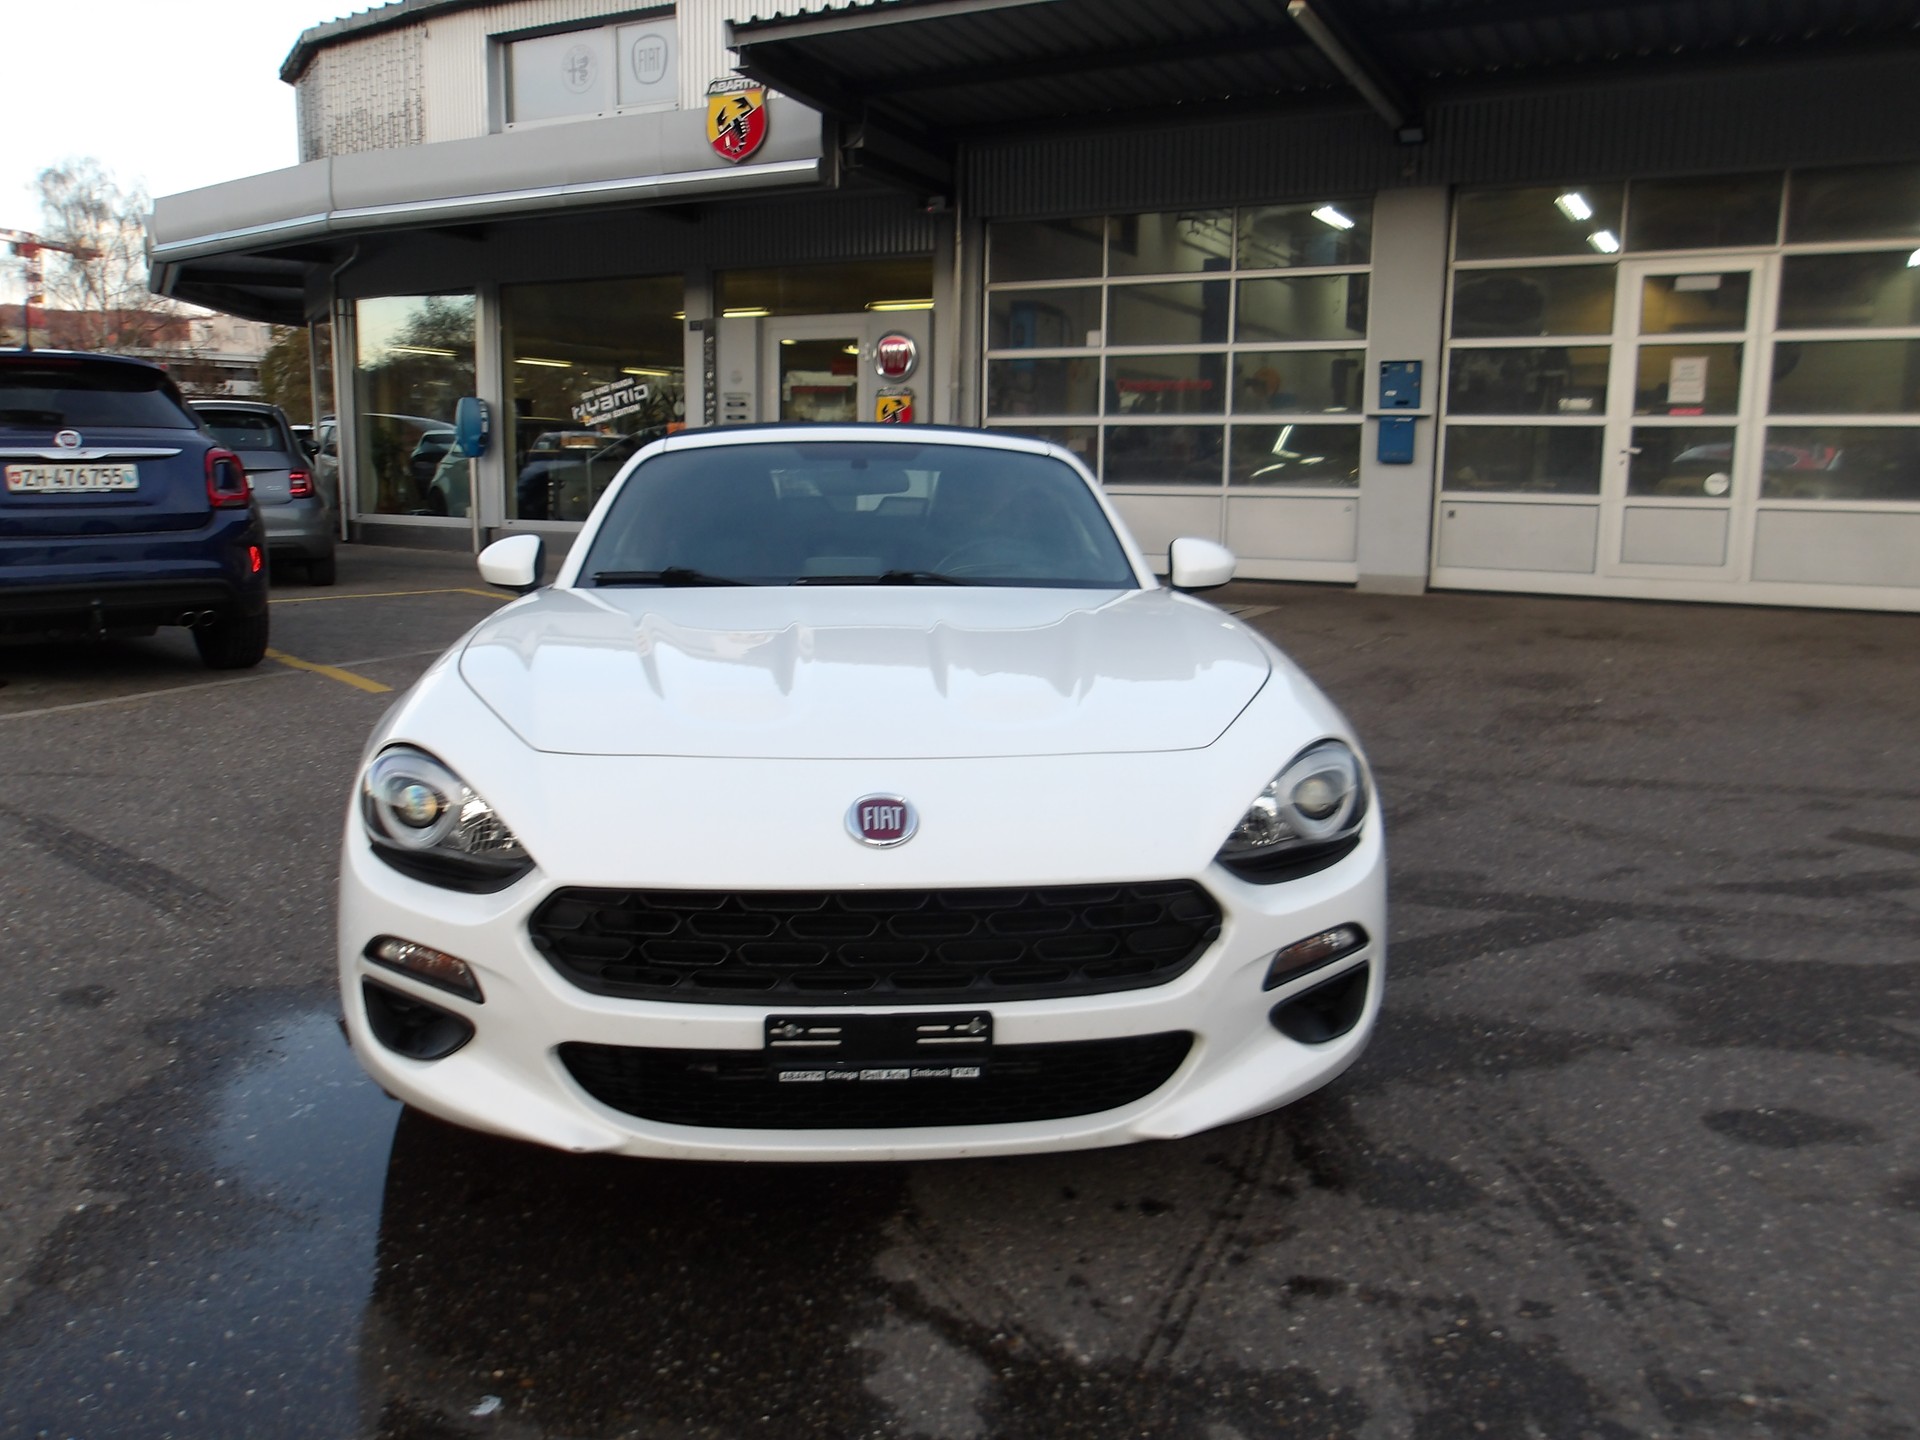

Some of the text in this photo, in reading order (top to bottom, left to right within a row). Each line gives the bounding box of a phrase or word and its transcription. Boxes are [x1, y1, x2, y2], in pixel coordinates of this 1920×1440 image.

[639, 46, 661, 72] FIAT
[708, 78, 761, 94] ABARTH
[571, 384, 649, 420] HYBRID
[863, 805, 904, 831] FIAT
